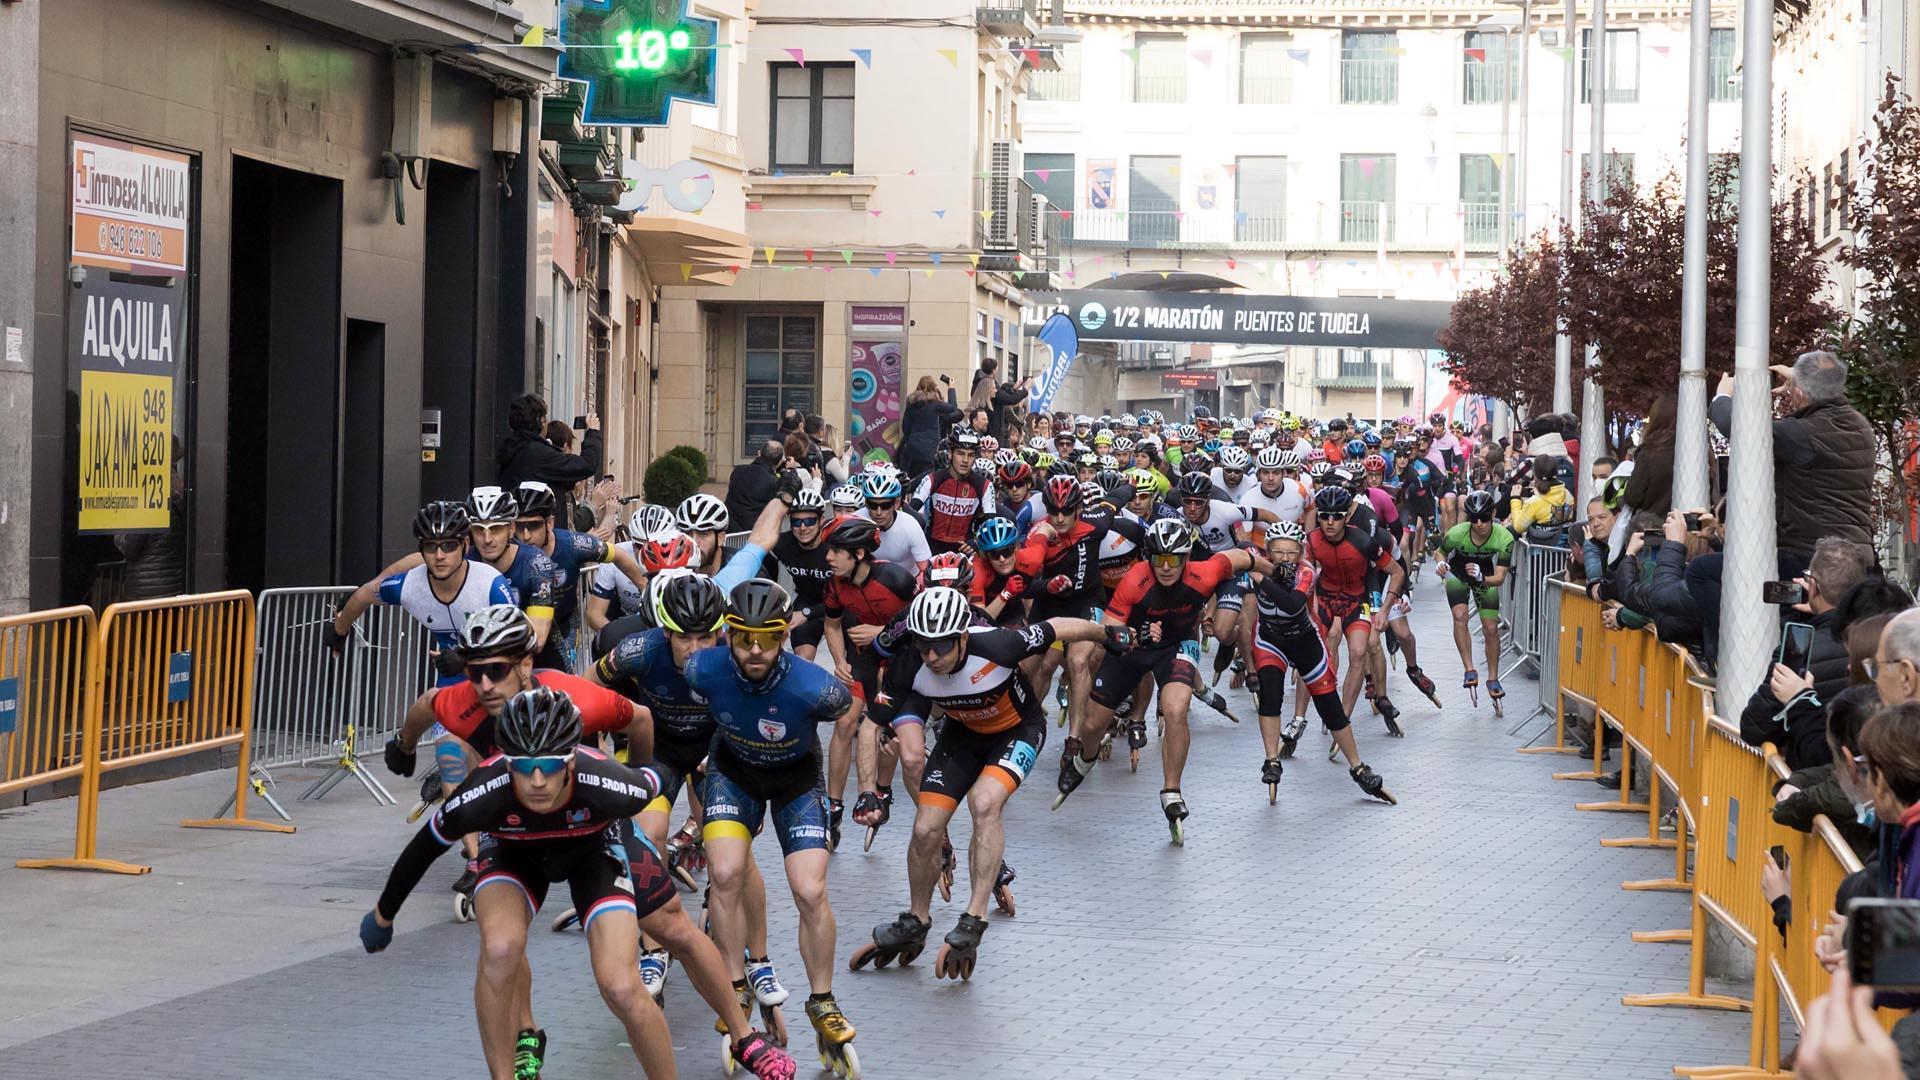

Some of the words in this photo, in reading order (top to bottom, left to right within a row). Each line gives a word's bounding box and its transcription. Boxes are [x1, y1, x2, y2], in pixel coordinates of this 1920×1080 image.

[140, 163, 185, 220] ALQUILA
[109, 224, 125, 252] 948
[128, 227, 145, 255] 822
[147, 229, 162, 257] 106
[82, 295, 173, 367] ALQUILA
[1113, 306, 1140, 328] 1/2
[1144, 304, 1224, 330] MARATÓN
[1234, 310, 1295, 332] PUENTES
[1298, 312, 1316, 333] DE
[1319, 312, 1370, 335] TUDELA
[143, 388, 166, 424] 948
[84, 388, 139, 489] JARAMA
[142, 430, 165, 467] 820
[142, 474, 164, 509] 123
[445, 796, 461, 813] CLUB
[462, 780, 486, 804] SADA
[578, 771, 600, 787] CLUB
[601, 777, 626, 795] SADA
[706, 804, 739, 817] 226ERS
